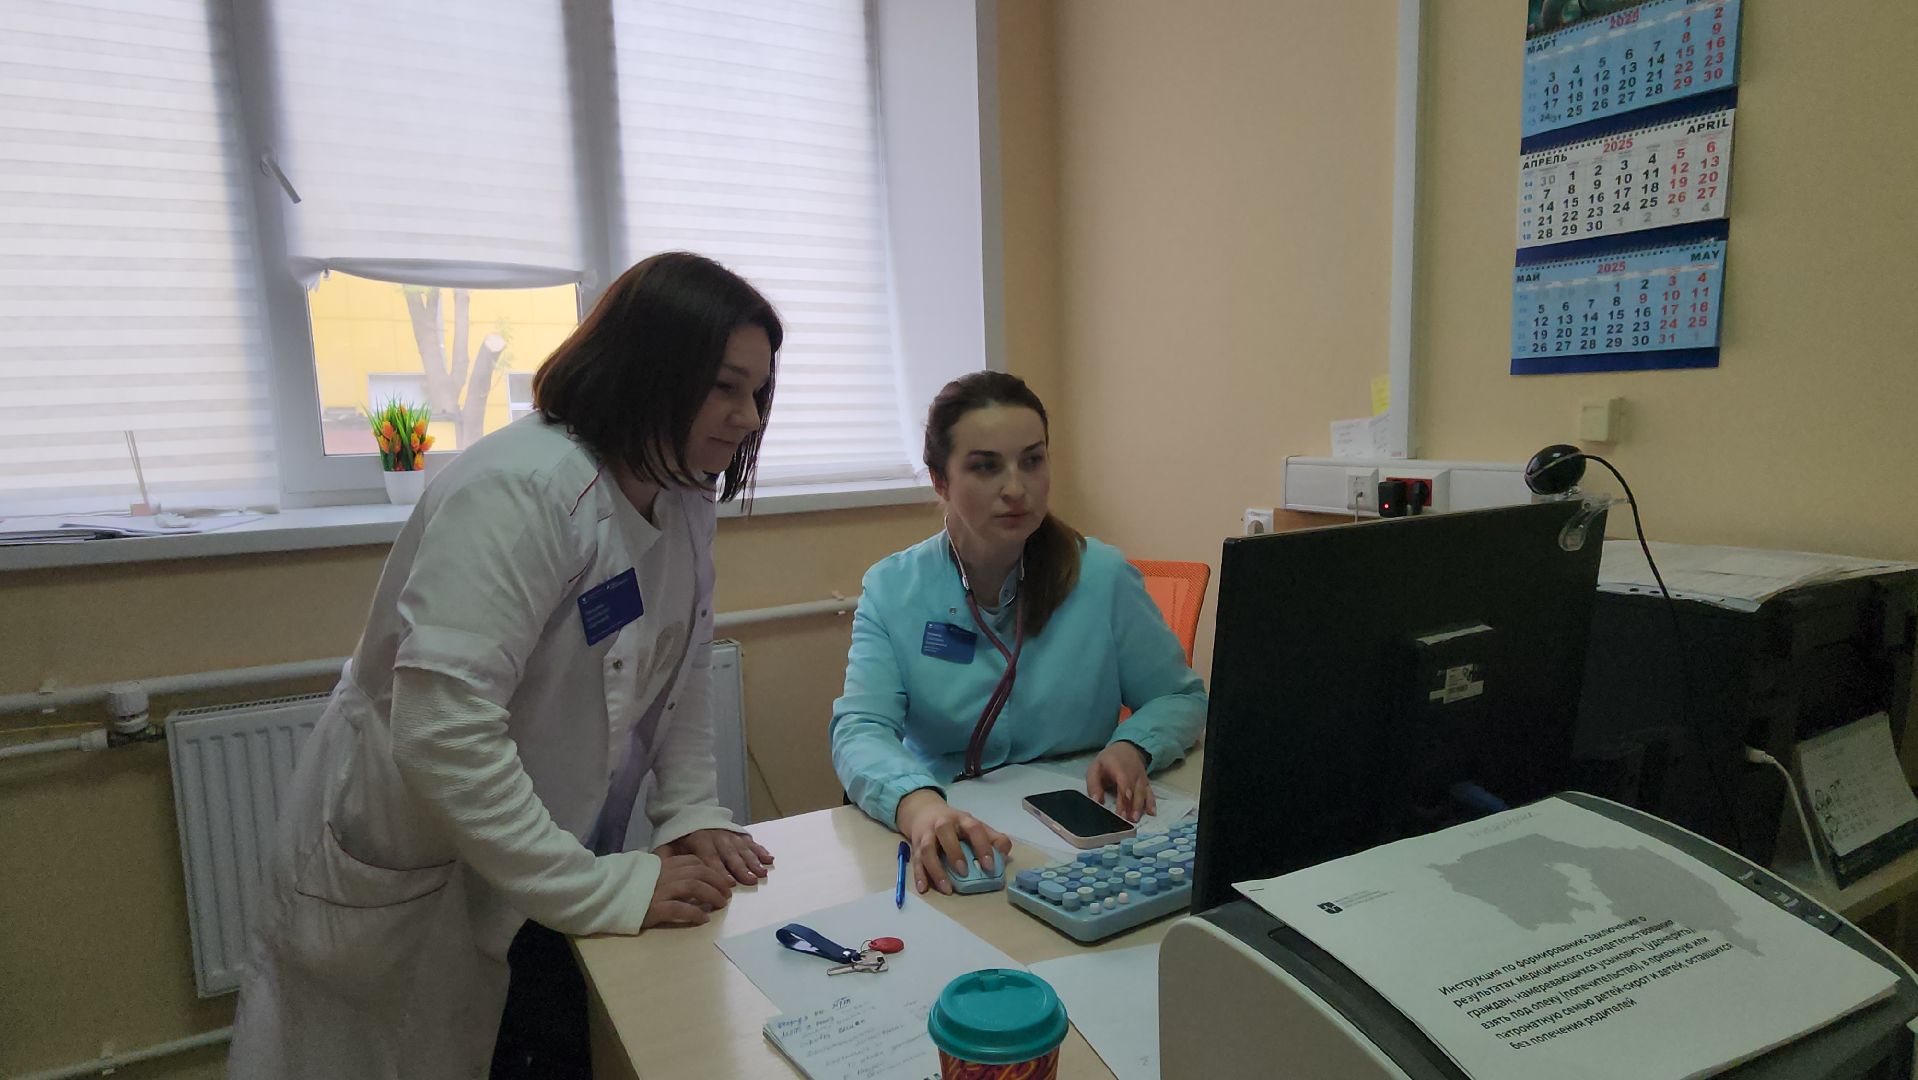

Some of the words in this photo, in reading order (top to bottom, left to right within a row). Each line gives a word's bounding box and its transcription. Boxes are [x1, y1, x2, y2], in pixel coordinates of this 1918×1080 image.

[1684, 16, 1690, 27] 1
[1715, 7, 1723, 19] 2
[1527, 39, 1556, 55] МАРТ
[1544, 84, 1559, 96] 10
[1568, 77, 1582, 90] 11
[1594, 70, 1610, 82] 12
[1621, 62, 1637, 75] 13
[1648, 53, 1664, 67] 14
[1676, 45, 1694, 59] 15
[1706, 36, 1725, 50] 16
[1549, 72, 1556, 82] 3
[1573, 65, 1580, 74] 4
[1600, 57, 1606, 67] 5
[1626, 49, 1633, 59] 6
[1654, 41, 1661, 51] 7
[1682, 32, 1690, 43] 8
[1712, 23, 1722, 34] 9
[1544, 98, 1558, 110] 17
[1568, 92, 1583, 104] 18
[1593, 84, 1609, 96] 19
[1619, 77, 1636, 90] 20
[1646, 69, 1662, 82] 21
[1675, 61, 1693, 75] 22
[1704, 52, 1723, 67] 23
[1567, 105, 1582, 118] 25
[1592, 98, 1608, 111] 26
[1618, 91, 1635, 105] 27
[1645, 84, 1663, 97] 28
[1674, 76, 1692, 90] 29
[1704, 68, 1723, 82] 30
[1604, 138, 1633, 152] 2025
[1687, 118, 1729, 135] APRIL
[1523, 154, 1568, 170] АПРЕЛЬ
[1541, 175, 1555, 187] 30
[1569, 170, 1575, 181] 1
[1595, 165, 1602, 176] 2
[1621, 160, 1628, 170] 3
[1648, 153, 1656, 164] 4
[1677, 148, 1686, 159] 5
[1707, 141, 1716, 153] 6
[1544, 189, 1551, 199] 7
[1568, 184, 1575, 194] 8
[1594, 179, 1601, 190] 9
[1616, 173, 1632, 185] 10
[1643, 168, 1659, 180] 11
[1671, 162, 1689, 174] 12
[1701, 155, 1719, 169] 13
[1538, 215, 1552, 226] 21
[1562, 210, 1578, 223] 22
[1587, 207, 1603, 218] 23
[1613, 201, 1630, 214] 24
[1640, 197, 1658, 209] 25
[1668, 192, 1686, 204] 26
[1697, 186, 1717, 199] 27
[1539, 201, 1554, 212] 14
[1563, 197, 1579, 209] 15
[1589, 192, 1604, 204] 16
[1614, 187, 1631, 199] 17
[1641, 182, 1659, 194] 18
[1670, 177, 1688, 189] 19
[1698, 171, 1718, 184] 20
[1538, 228, 1553, 239] 28
[1561, 224, 1577, 235] 29
[1586, 220, 1602, 232] 30
[1672, 207, 1680, 218] 3
[1702, 202, 1710, 211] 4
[1597, 261, 1626, 273] 2025
[1690, 250, 1719, 262] MAY
[1538, 304, 1545, 314] 5
[1562, 302, 1569, 311] 6
[1588, 299, 1595, 309] 7
[1613, 296, 1621, 306] 8
[1639, 293, 1647, 304] 9
[1663, 290, 1680, 301] 10
[1692, 287, 1709, 298] 11
[1615, 282, 1620, 292] 1
[1641, 279, 1649, 289] 2
[1668, 275, 1677, 286] 3
[1697, 272, 1706, 283] 4
[1533, 330, 1548, 340] 19
[1556, 328, 1572, 338] 20
[1581, 326, 1596, 337] 21
[1606, 323, 1624, 335] 22
[1632, 321, 1650, 332] 23
[1660, 318, 1677, 330] 24
[1688, 315, 1707, 328] 25
[1534, 316, 1549, 327] 12
[1557, 314, 1573, 325] 13
[1583, 312, 1599, 322] 14
[1608, 310, 1624, 320] 15
[1634, 307, 1651, 318] 16
[1662, 304, 1679, 315] 17
[1690, 302, 1708, 313] 18
[1532, 343, 1547, 353] 26
[1555, 341, 1571, 352] 27
[1580, 339, 1596, 350] 28
[1606, 337, 1622, 348] 29
[1632, 335, 1649, 346] 30
[1659, 333, 1675, 344] 31
[1438, 969, 1502, 996] Инструкция
[1501, 964, 1516, 975] по
[1516, 934, 1587, 968] формированию
[1584, 918, 1639, 940] Заключения
[1453, 979, 1515, 1008] результатах
[1515, 953, 1584, 984] медицинского
[1584, 919, 1674, 957] освидетельствования
[1466, 996, 1517, 1019] граждан,
[1515, 963, 1598, 1000] намеревающихся
[1597, 946, 1646, 970] усыновить
[1481, 1014, 1511, 1030] взять
[1510, 1007, 1533, 1019] под
[1531, 995, 1563, 1011] опеку
[1559, 962, 1646, 1001] (попечительство),
[1641, 959, 1650, 967] в
[1692, 936, 1711, 947] или
[1496, 1011, 1564, 1040] патронатную
[1561, 999, 1595, 1016] семью
[1594, 975, 1652, 1003] детей-сирот
[1649, 971, 1660, 980] и
[1658, 960, 1688, 977] детей,
[1685, 943, 1733, 965] оставшихся
[1509, 1038, 1531, 1050] без
[1530, 1020, 1586, 1045] попечения
[1583, 997, 1637, 1026] родителей
